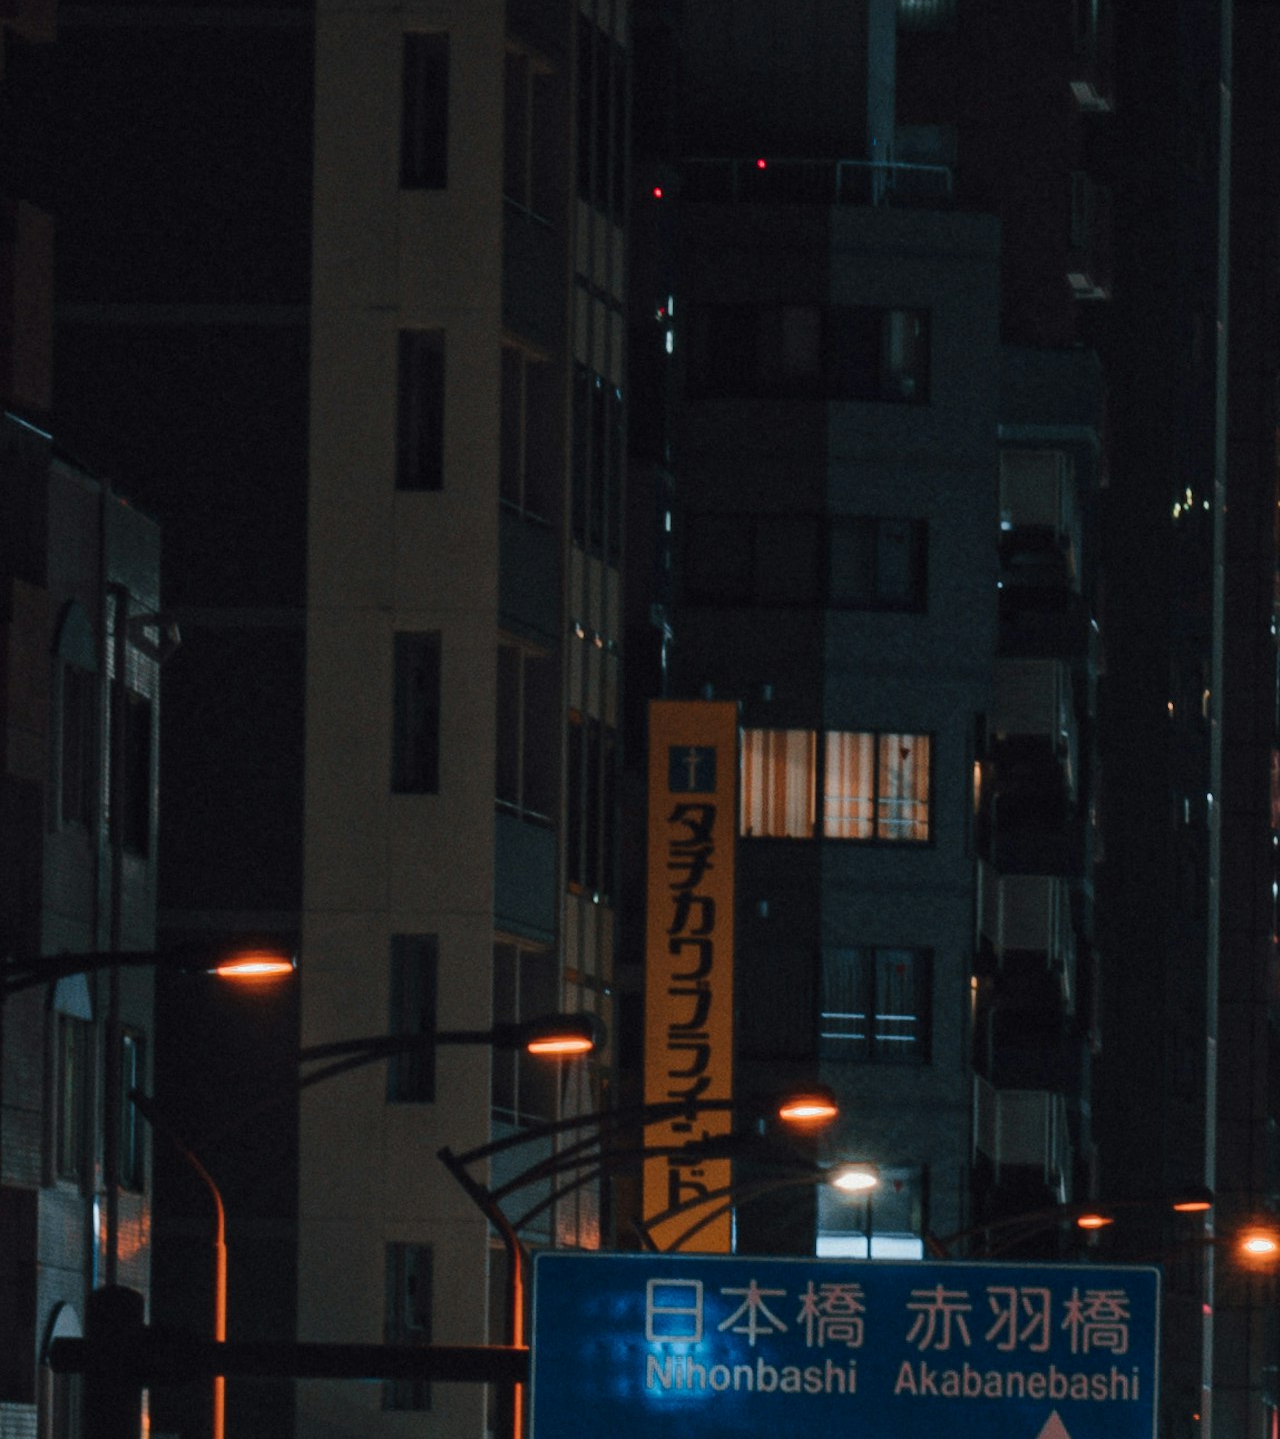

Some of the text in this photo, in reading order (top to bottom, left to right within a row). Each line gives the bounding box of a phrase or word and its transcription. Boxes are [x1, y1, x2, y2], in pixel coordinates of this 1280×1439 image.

[645, 1278, 1130, 1354] 日本橋 赤羽橋
[646, 1355, 1140, 1401] Nihonbashi Akabanebashi
